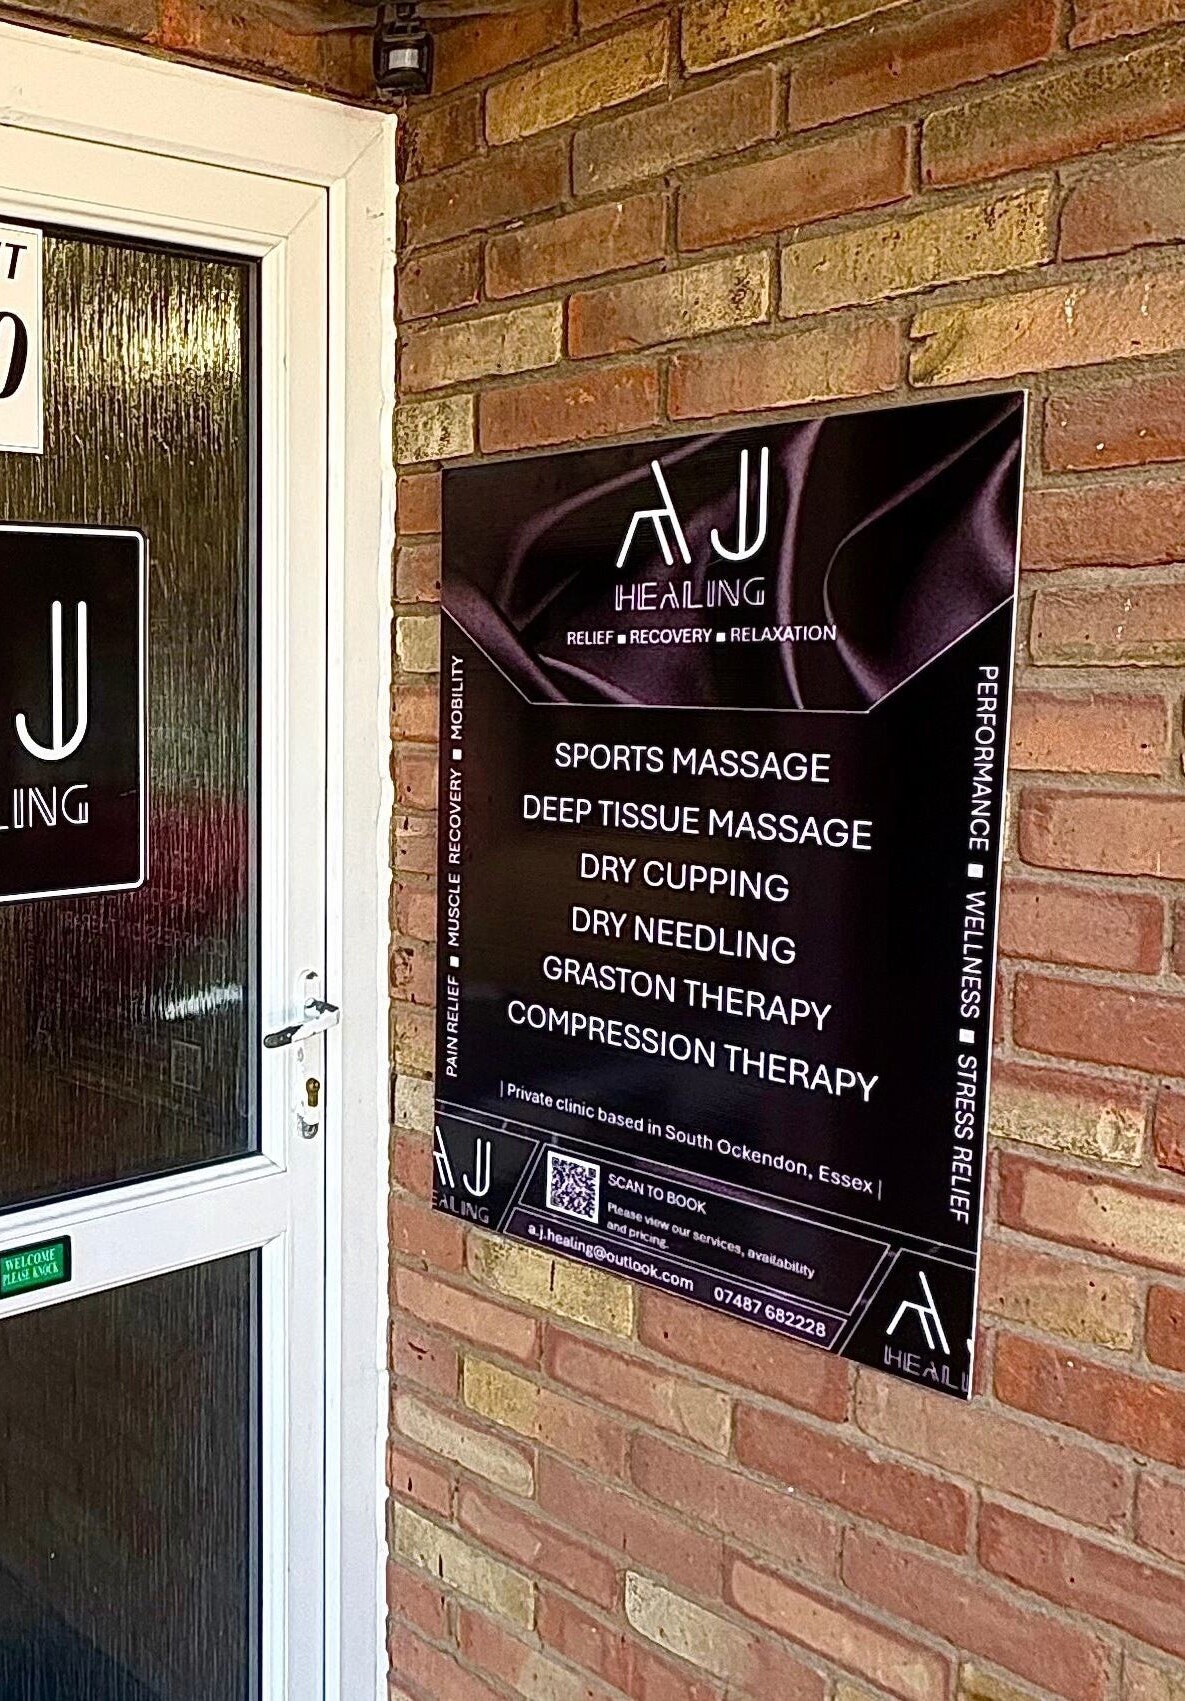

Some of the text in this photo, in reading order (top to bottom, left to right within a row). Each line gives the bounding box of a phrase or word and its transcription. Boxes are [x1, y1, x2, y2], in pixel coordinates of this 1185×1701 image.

[617, 447, 768, 567] AJ
[616, 577, 764, 610] HEALING
[568, 625, 836, 644] RELIEF RECOVERY RELAXATION
[555, 743, 830, 782] SPORTS MASSAGE
[524, 795, 872, 850] DEEP TISSUE MASSAGE
[446, 656, 463, 1077] PAIN RELIEF MUSCLE RECOVERY MOBILITY
[581, 853, 789, 901] DRY CUPPING
[573, 907, 795, 964] DRY NEEDLING
[950, 667, 998, 1224] PERFORMANCE WELLNESS STRESS RELIEF
[544, 956, 831, 1030] GRASTON THERAPY
[508, 1001, 878, 1101] COMPRESSION THERAPY
[508, 1084, 872, 1193] Private clinic based in South Ockendon, Essex
[609, 1174, 706, 1214] SCAN TO BOOK
[607, 1222, 627, 1234] and
[608, 1202, 814, 1280] Please view our services, availability
[2, 1261, 59, 1287] PLEASE KNOCK
[5, 1248, 56, 1271] WELCOME
[528, 1224, 825, 1337] a.j.healing@outlook.com 07487 682228
